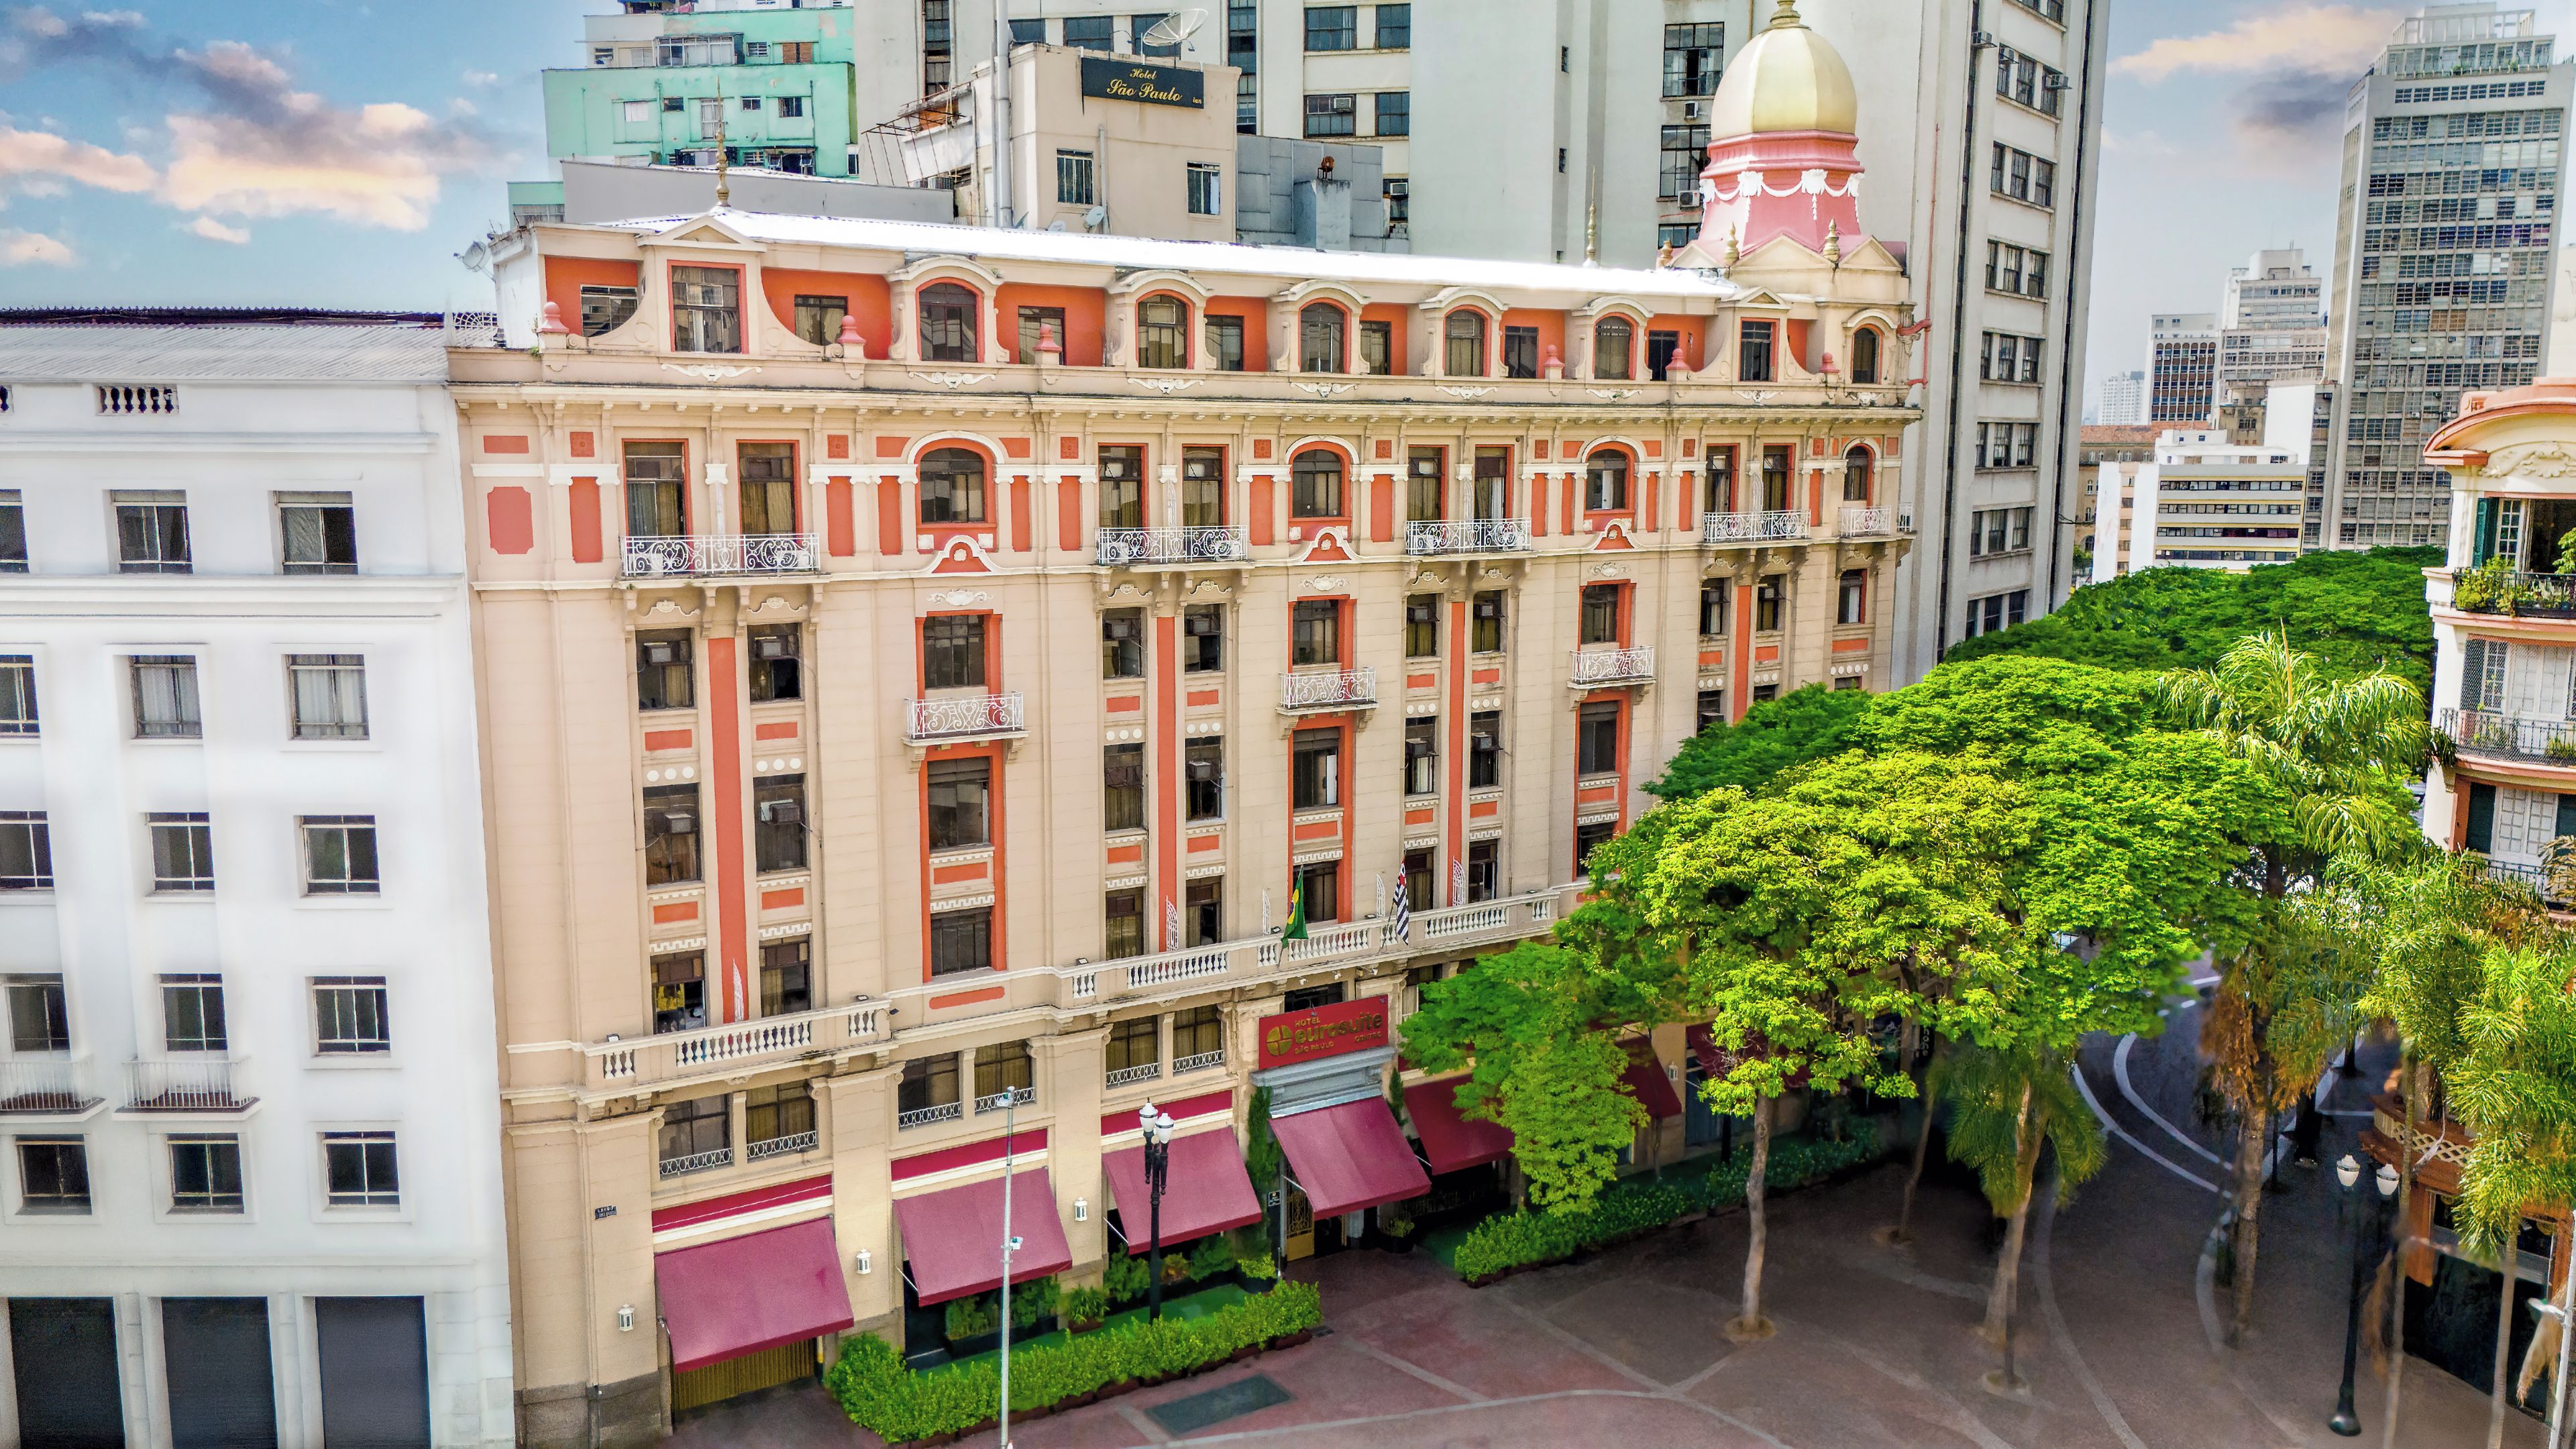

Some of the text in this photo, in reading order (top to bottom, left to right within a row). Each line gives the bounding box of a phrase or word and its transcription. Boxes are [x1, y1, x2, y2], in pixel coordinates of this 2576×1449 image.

[1130, 68, 1157, 79] Hotel
[1106, 79, 1137, 97] São
[1138, 83, 1183, 101] Paulo
[1295, 1017, 1320, 1027] HOTEL
[1295, 1012, 1382, 1043] eurosuite
[1354, 1031, 1382, 1042] CENTRO
[1311, 1040, 1334, 1051] PAULO
